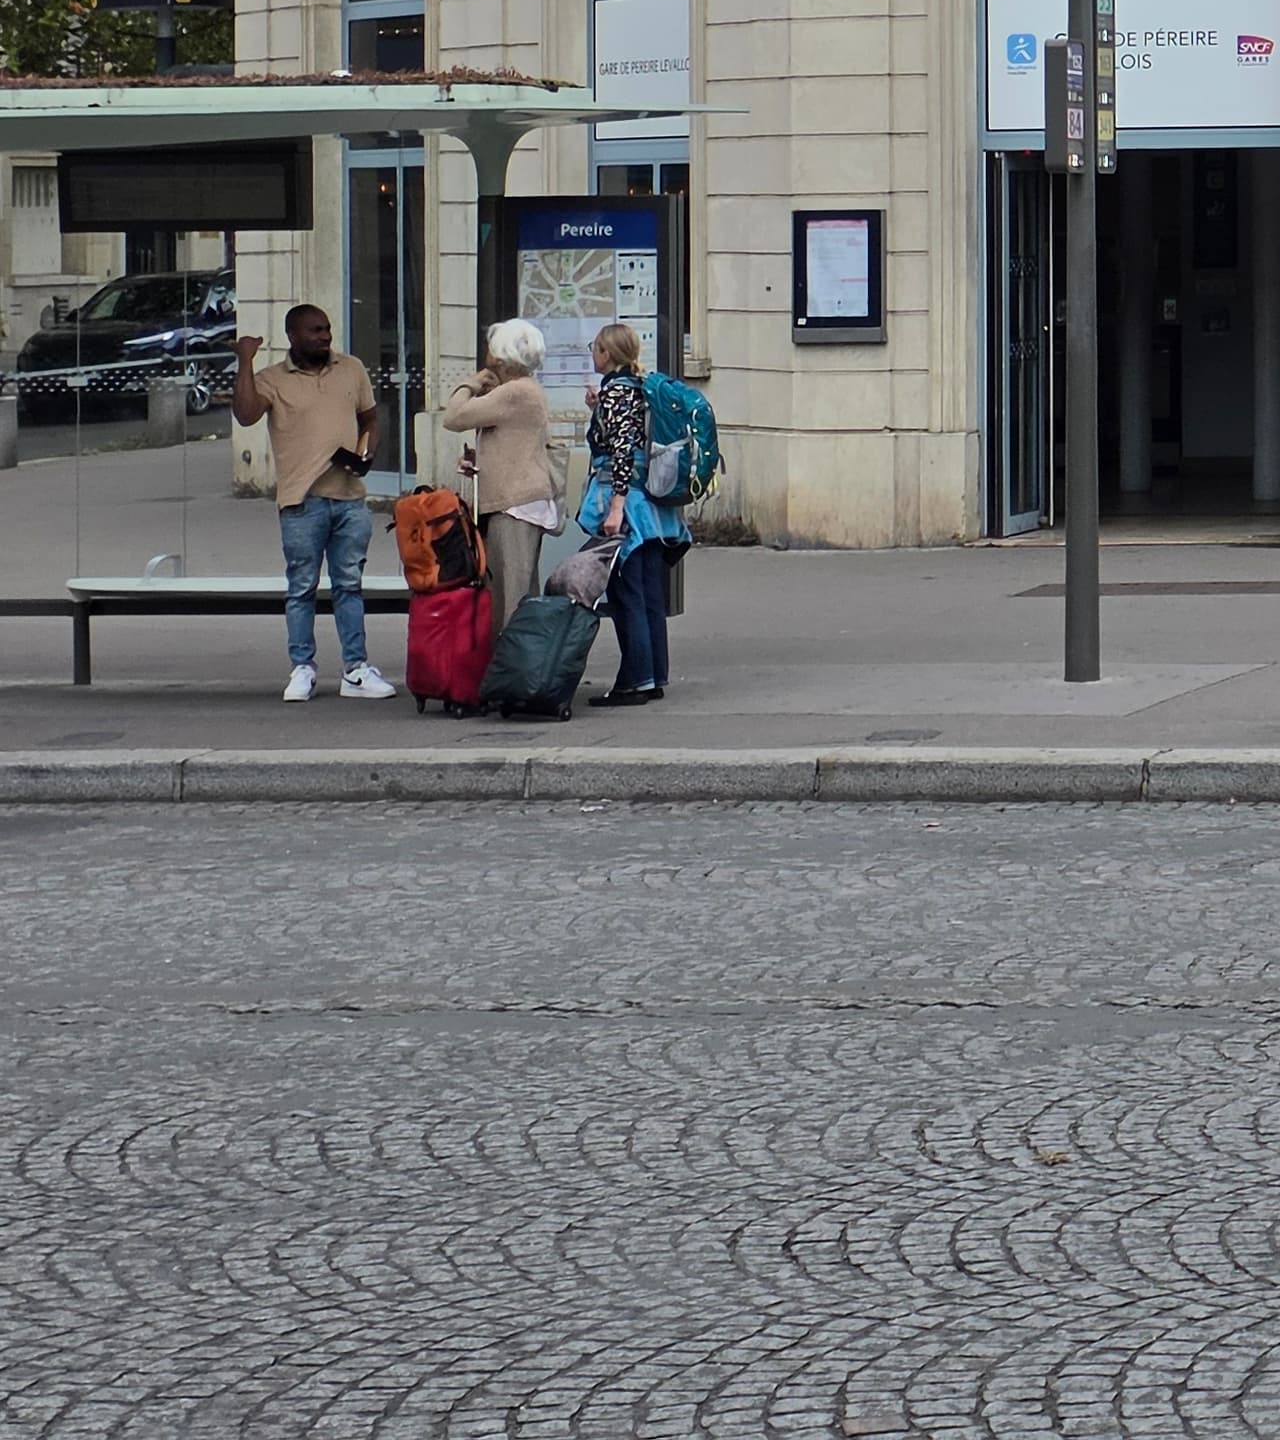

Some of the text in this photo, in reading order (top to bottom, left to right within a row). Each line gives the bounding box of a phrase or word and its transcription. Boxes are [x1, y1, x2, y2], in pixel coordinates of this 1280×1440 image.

[1144, 27, 1219, 47] PÉREIRE
[600, 62, 618, 76] GARE
[621, 61, 629, 75] DE
[1069, 111, 1081, 136] 84
[561, 222, 613, 237] Pereire
